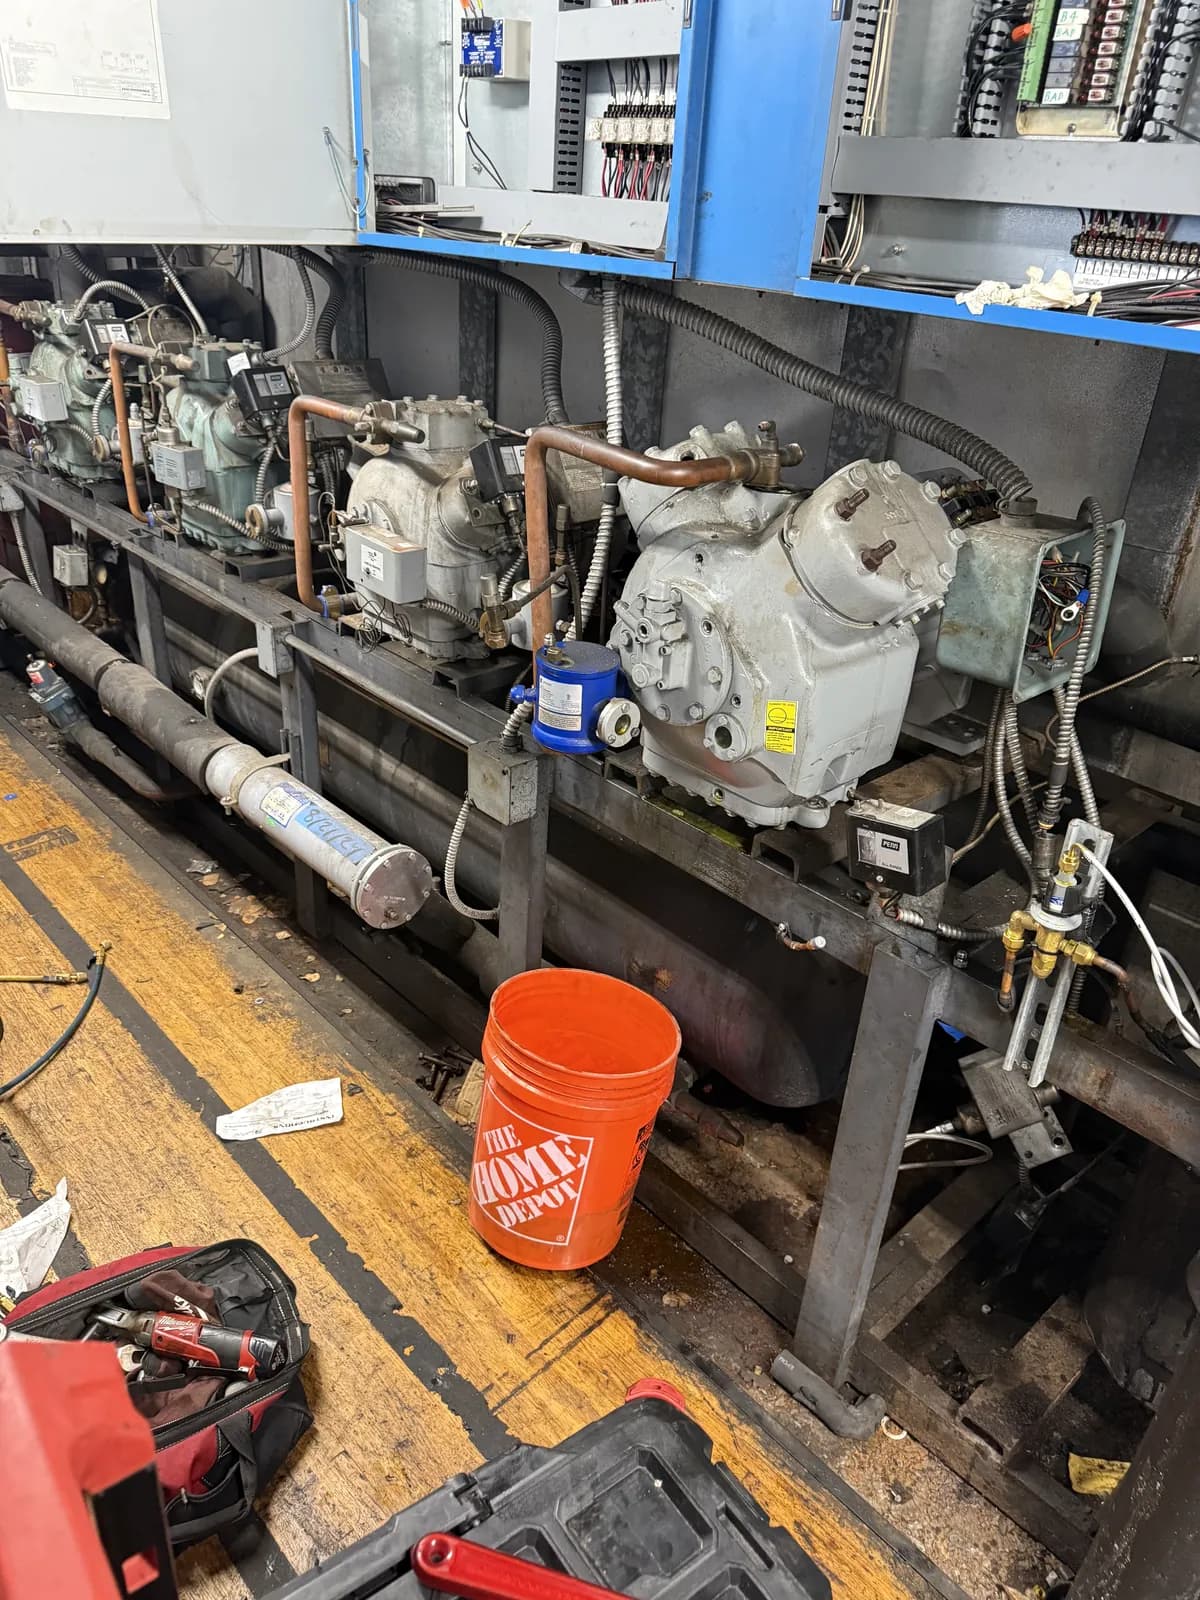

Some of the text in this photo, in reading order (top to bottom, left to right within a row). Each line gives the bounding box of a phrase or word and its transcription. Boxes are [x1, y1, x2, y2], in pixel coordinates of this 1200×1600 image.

[882, 840, 899, 850] PENN
[482, 1124, 523, 1155] THE
[474, 1134, 588, 1205] HOME
[495, 1178, 579, 1229] DEPOT
